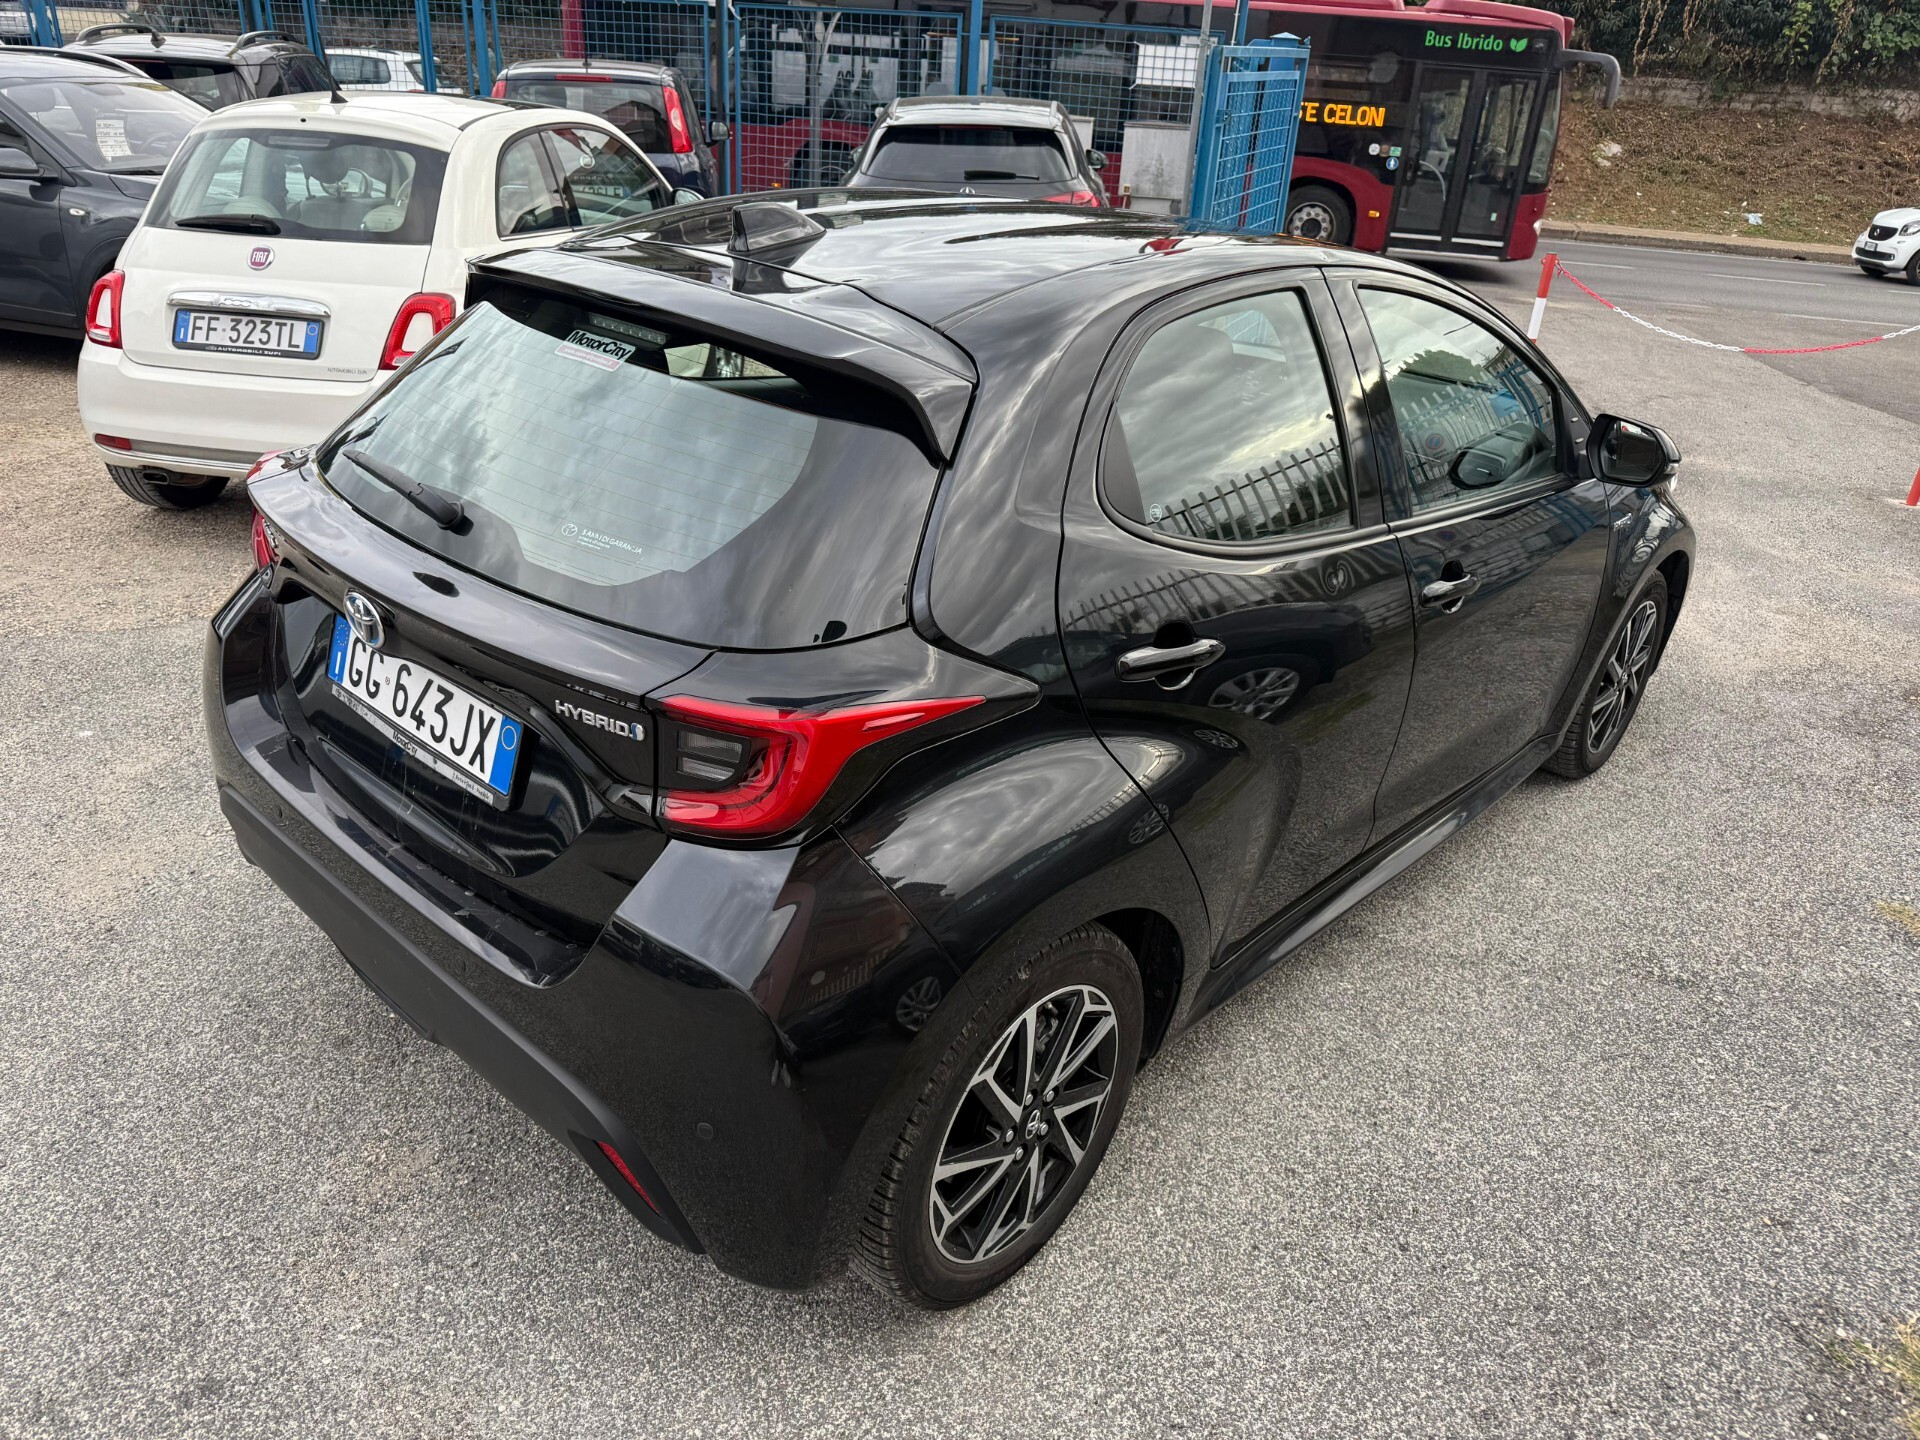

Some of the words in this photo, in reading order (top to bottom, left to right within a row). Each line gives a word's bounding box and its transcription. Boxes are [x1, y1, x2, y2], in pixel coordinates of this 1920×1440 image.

[1425, 30, 1452, 47] Bus
[1457, 32, 1503, 51] Ibrido
[251, 250, 269, 263] FIAT
[191, 315, 220, 341] FF
[228, 318, 300, 349] 323TL
[566, 330, 632, 360] MotorCity
[217, 346, 262, 354] AUTOMOBILI
[349, 635, 385, 700] GG
[392, 663, 497, 775] 643JX
[554, 699, 630, 738] HYBRID
